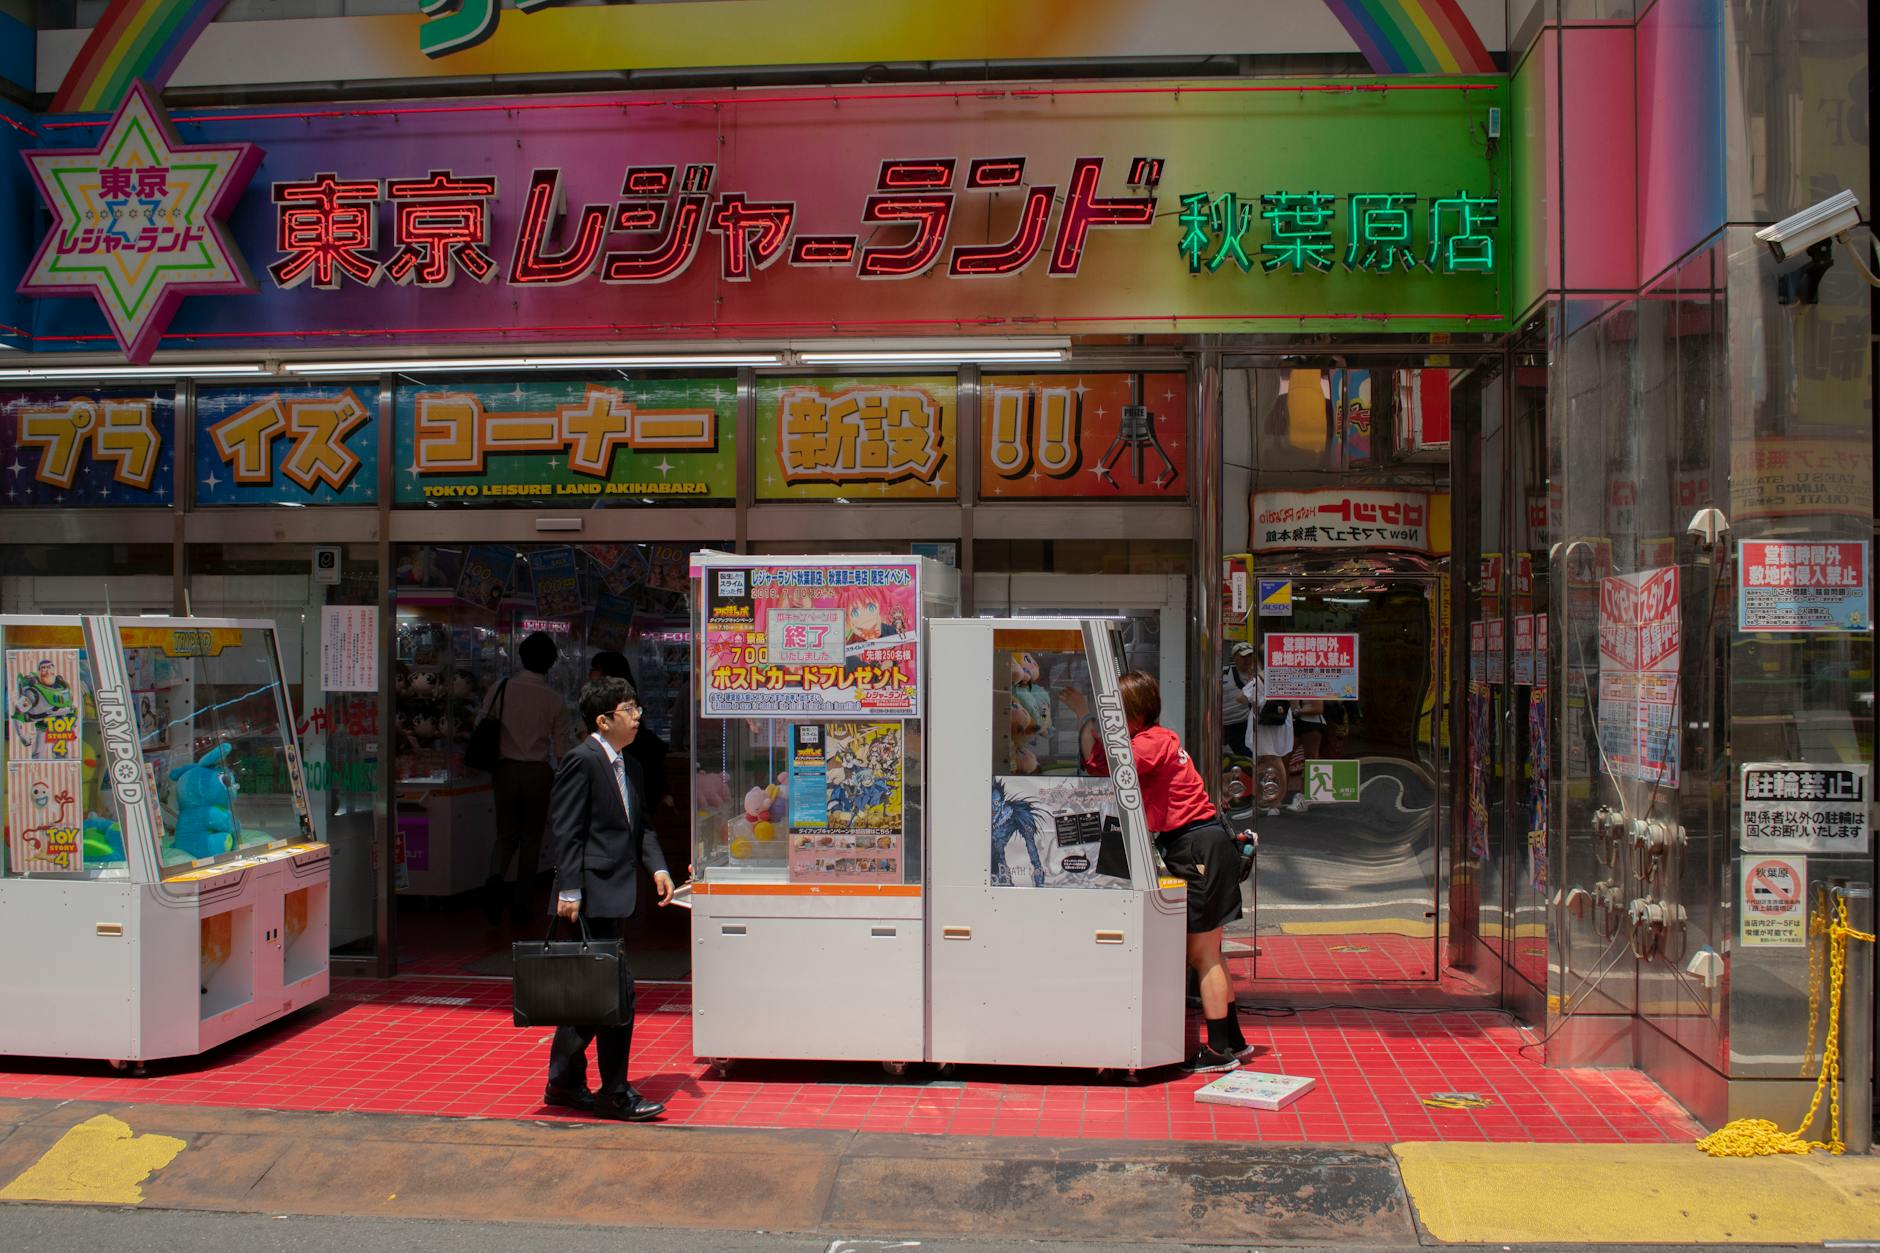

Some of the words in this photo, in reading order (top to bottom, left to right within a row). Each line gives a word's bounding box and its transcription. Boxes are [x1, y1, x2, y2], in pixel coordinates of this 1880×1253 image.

[99, 166, 169, 199] 東京
[267, 158, 1165, 290] 東京レジャーランド
[1178, 190, 1498, 275] 秋葉原店
[56, 226, 204, 254] レジャーランド
[423, 486, 478, 497] TOKYO
[482, 485, 552, 496] LEISURE
[556, 484, 602, 495] LAND
[605, 483, 708, 495] AKIHABARA
[1764, 545, 1841, 565] 営業時間外
[1749, 565, 1857, 585] 敷地内侵入禁止
[783, 625, 831, 650] 終了
[1283, 637, 1339, 652] 営業時間外
[866, 649, 912, 660] 先着250名様
[1271, 651, 1351, 667] 敷地内侵入禁止
[712, 665, 910, 691] ポストカードプレゼント
[45, 716, 77, 733] TOY
[52, 739, 68, 755] 4
[97, 685, 145, 804] TRYPOD
[1097, 690, 1142, 810] TRYPOD
[1746, 772, 1862, 800] 駐輪禁止!
[1744, 811, 1865, 825] 関係者以外の駐輪は
[47, 828, 79, 845] TOY
[1746, 824, 1862, 839] 固くお断りいたします
[49, 844, 75, 852] STORY
[54, 851, 70, 868] 4
[1756, 867, 1790, 879] 秋葉原
